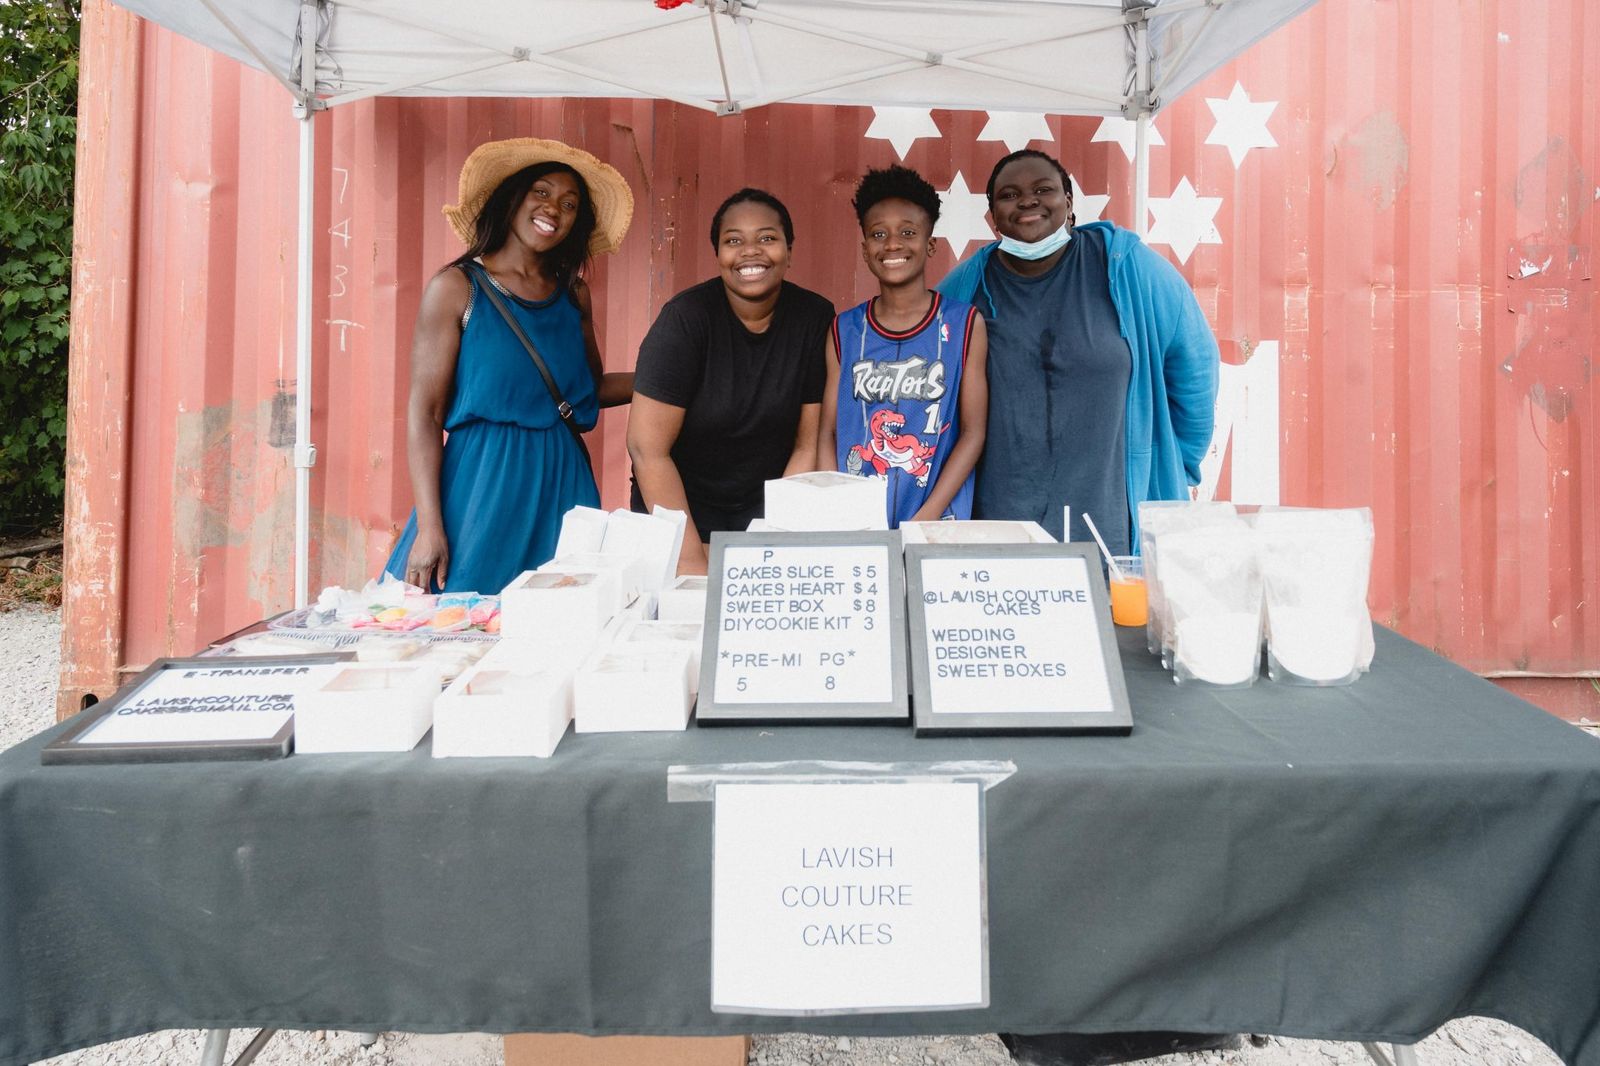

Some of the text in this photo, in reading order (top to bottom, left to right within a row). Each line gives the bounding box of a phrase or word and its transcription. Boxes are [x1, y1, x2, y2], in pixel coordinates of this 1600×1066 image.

[923, 403, 940, 434] 1
[763, 550, 774, 563] P
[727, 566, 782, 580] CAKES
[787, 565, 834, 579] SLICE
[726, 583, 785, 597] CAKES
[790, 582, 845, 596] HEART
[1002, 589, 1087, 603] COUTURE
[726, 600, 785, 613] SWEET
[789, 599, 824, 613] BOX
[983, 602, 1041, 616] CAKES
[825, 616, 851, 630] KIT
[864, 616, 874, 631] 3
[932, 628, 1016, 642] WEDDING
[935, 645, 1027, 660] DESIGNER
[937, 663, 1067, 678] SWEET BOXES
[737, 675, 836, 692] 5 8
[801, 847, 894, 869] LAVISH
[781, 884, 913, 907] COUTURE
[802, 923, 893, 946] CAKES
